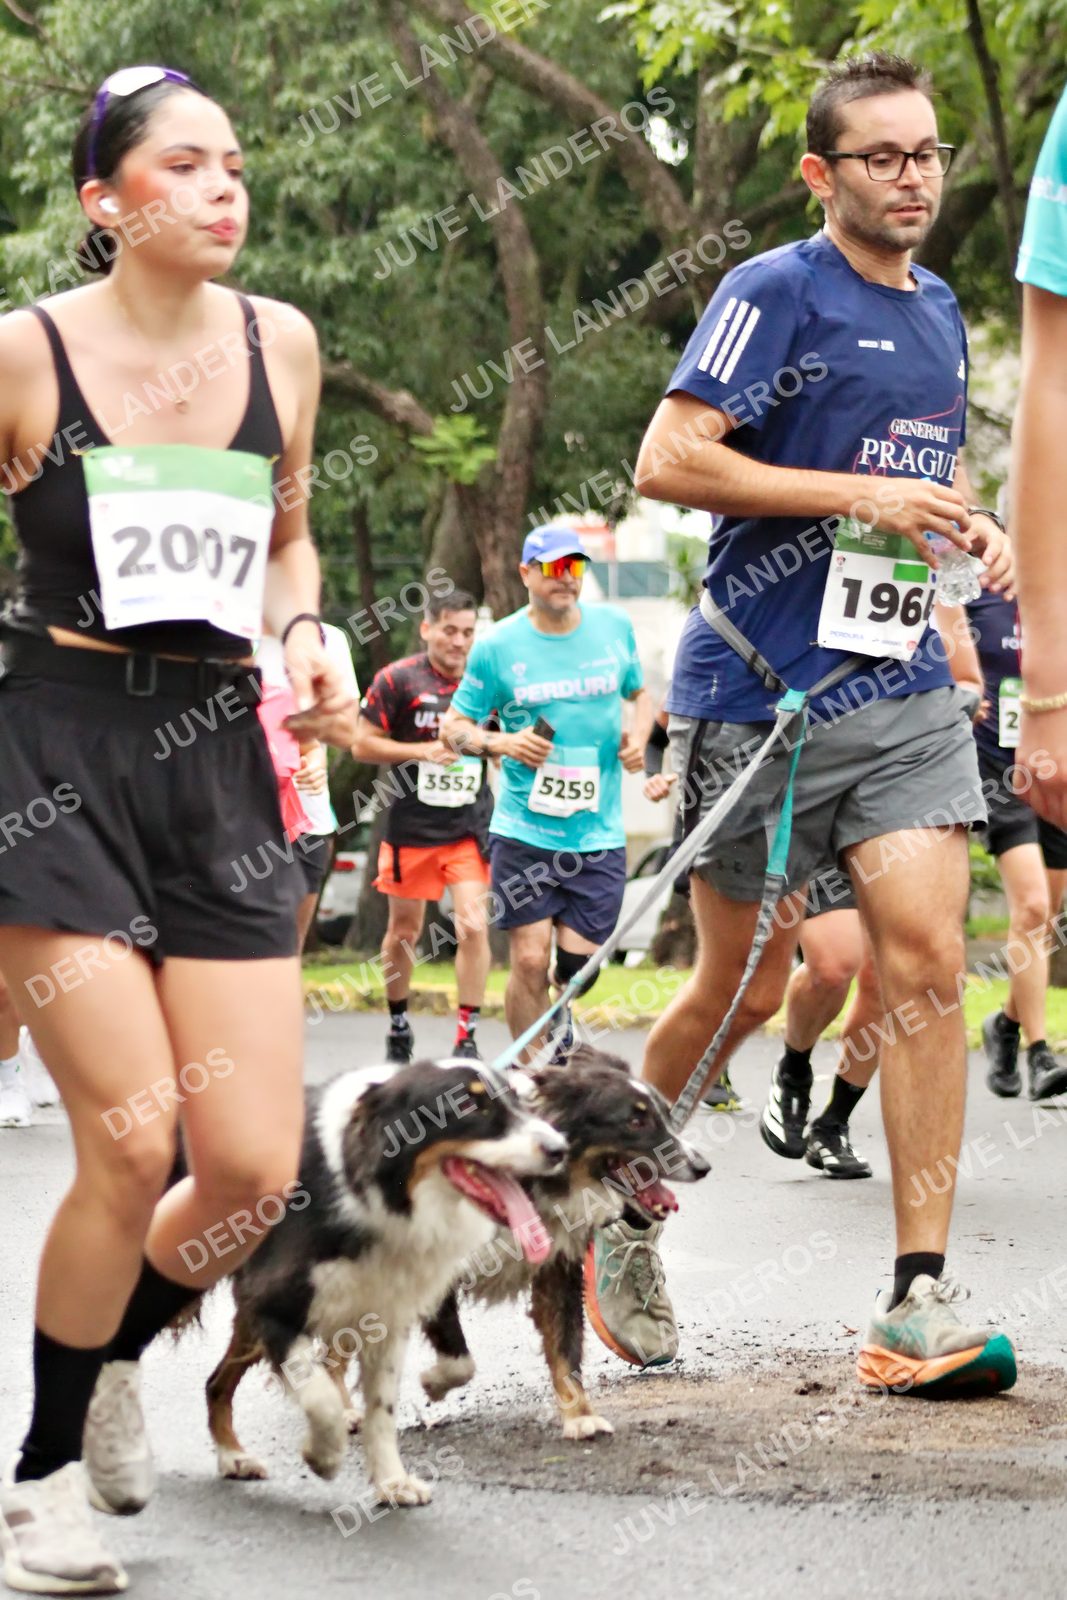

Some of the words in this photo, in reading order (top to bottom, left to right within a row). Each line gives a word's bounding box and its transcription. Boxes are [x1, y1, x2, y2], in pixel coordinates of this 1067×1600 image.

[891, 418, 949, 443] GENERALI
[112, 523, 257, 588] 2007
[514, 675, 617, 706] PERDURA
[425, 774, 476, 791] 3552
[539, 776, 595, 800] 5259
